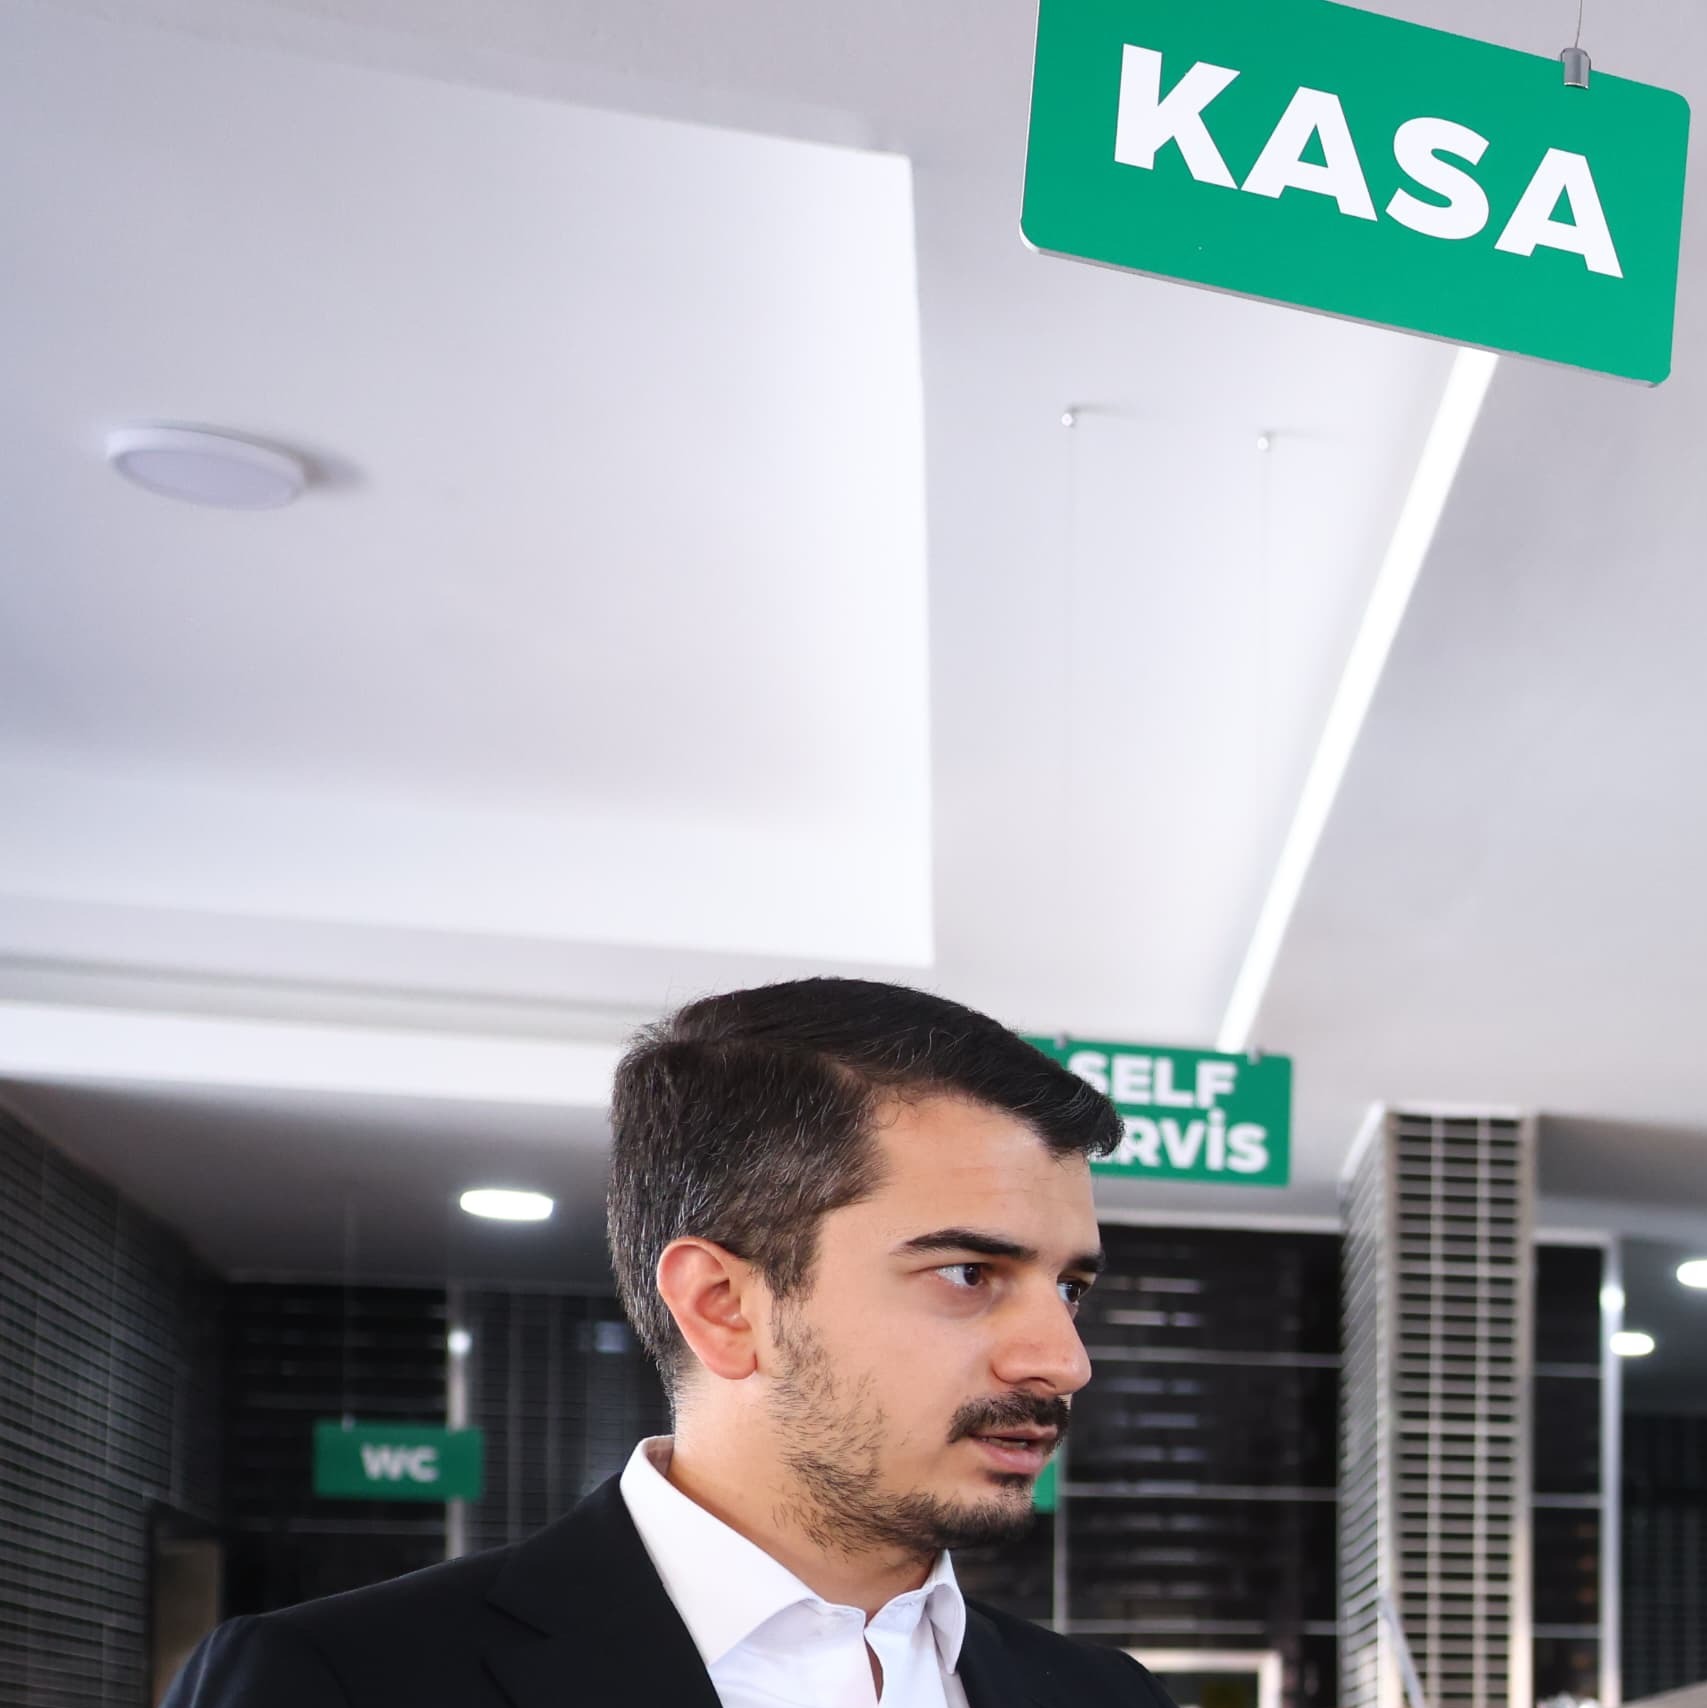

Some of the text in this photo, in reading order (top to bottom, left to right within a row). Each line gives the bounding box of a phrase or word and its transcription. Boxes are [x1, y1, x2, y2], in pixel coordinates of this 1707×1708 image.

[1114, 43, 1623, 278] KASA
[1067, 1051, 1238, 1110] SELF
[1088, 1108, 1269, 1174] RVİS
[361, 1443, 439, 1482] WC
